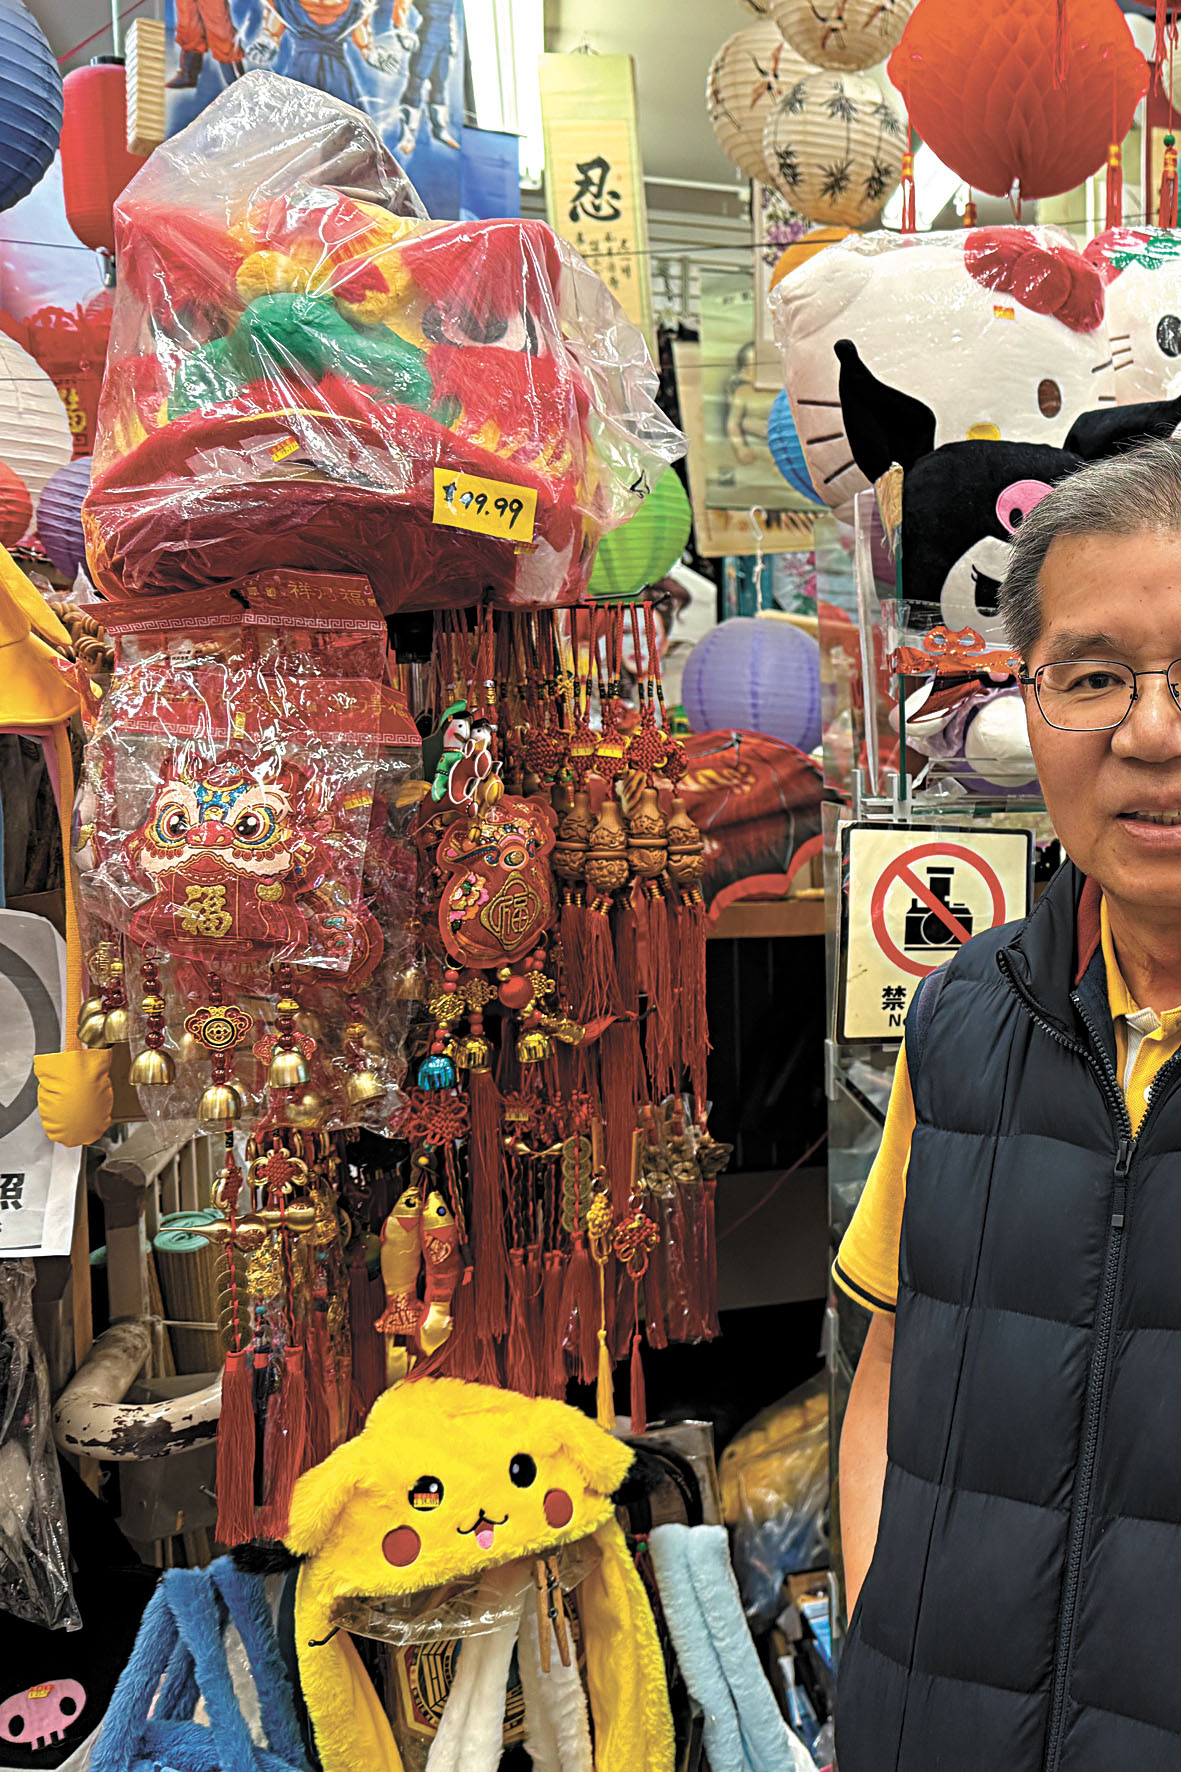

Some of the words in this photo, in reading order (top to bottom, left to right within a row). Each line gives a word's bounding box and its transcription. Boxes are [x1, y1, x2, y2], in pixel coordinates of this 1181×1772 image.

[569, 156, 621, 222] 忍
[177, 885, 232, 937] 福
[499, 892, 530, 936] 福
[882, 985, 906, 1011] 禁
[889, 1014, 905, 1027] N
